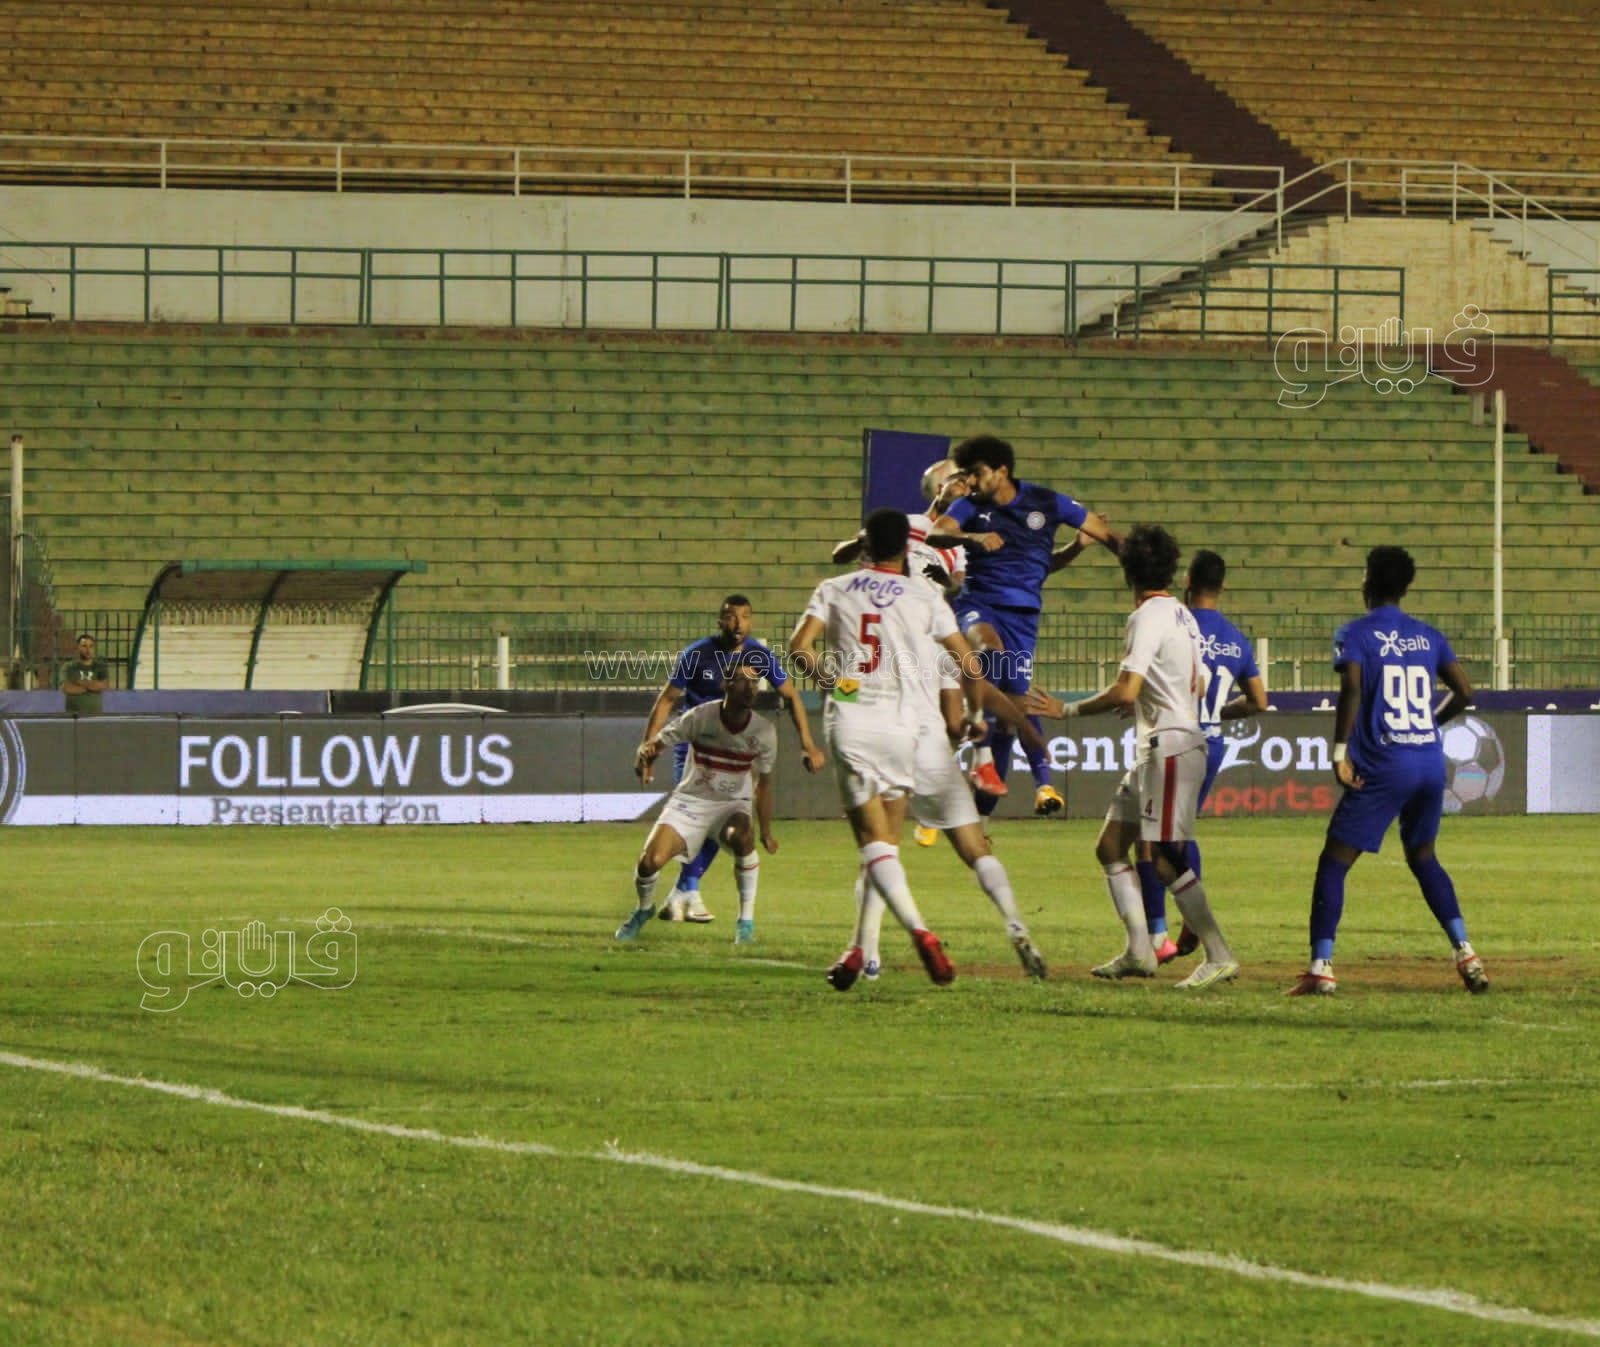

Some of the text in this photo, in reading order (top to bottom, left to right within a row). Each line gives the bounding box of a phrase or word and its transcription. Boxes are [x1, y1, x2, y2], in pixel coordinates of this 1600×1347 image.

[858, 613, 882, 674] 5
[1214, 639, 1242, 658] saib
[1398, 634, 1431, 652] saib
[1383, 664, 1434, 730] 99
[179, 733, 514, 788] FOLLOW US
